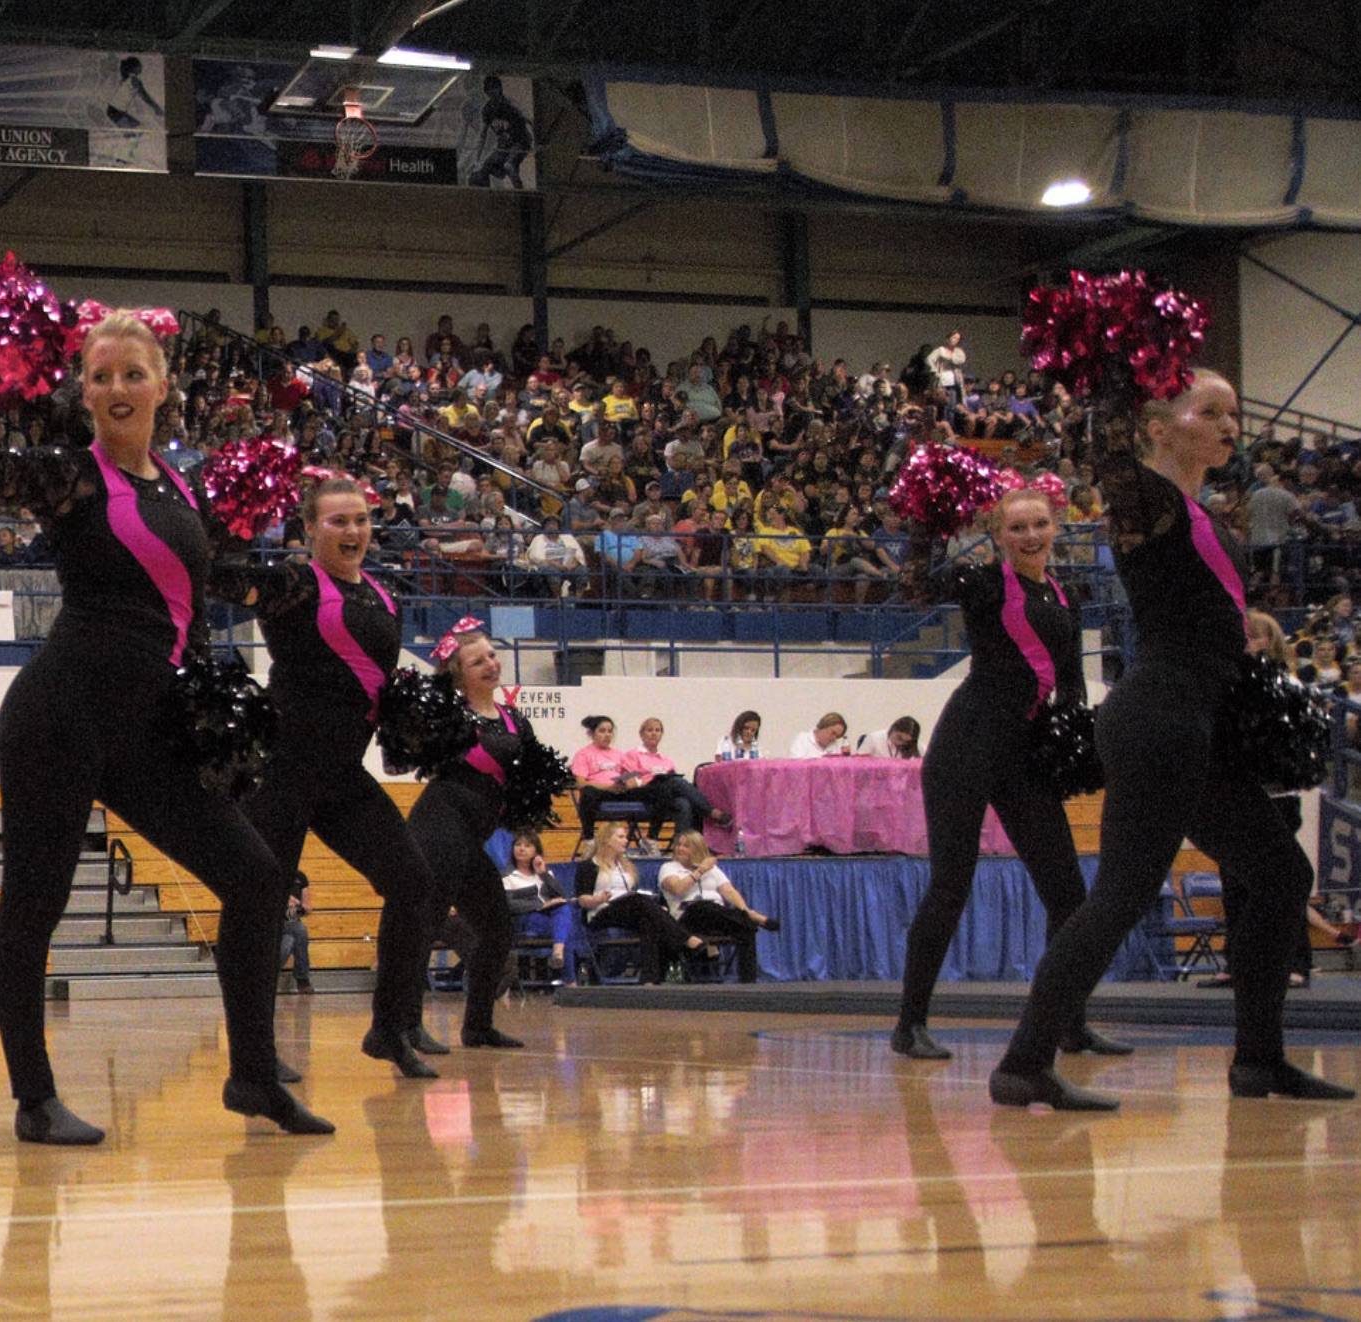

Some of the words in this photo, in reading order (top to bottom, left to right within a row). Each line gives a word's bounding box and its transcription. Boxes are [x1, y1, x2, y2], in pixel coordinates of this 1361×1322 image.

[1, 129, 53, 145] UNION
[6, 148, 68, 163] AGENCY
[390, 159, 435, 174] Health
[514, 691, 562, 704] EVENS
[520, 706, 566, 719] DENTS
